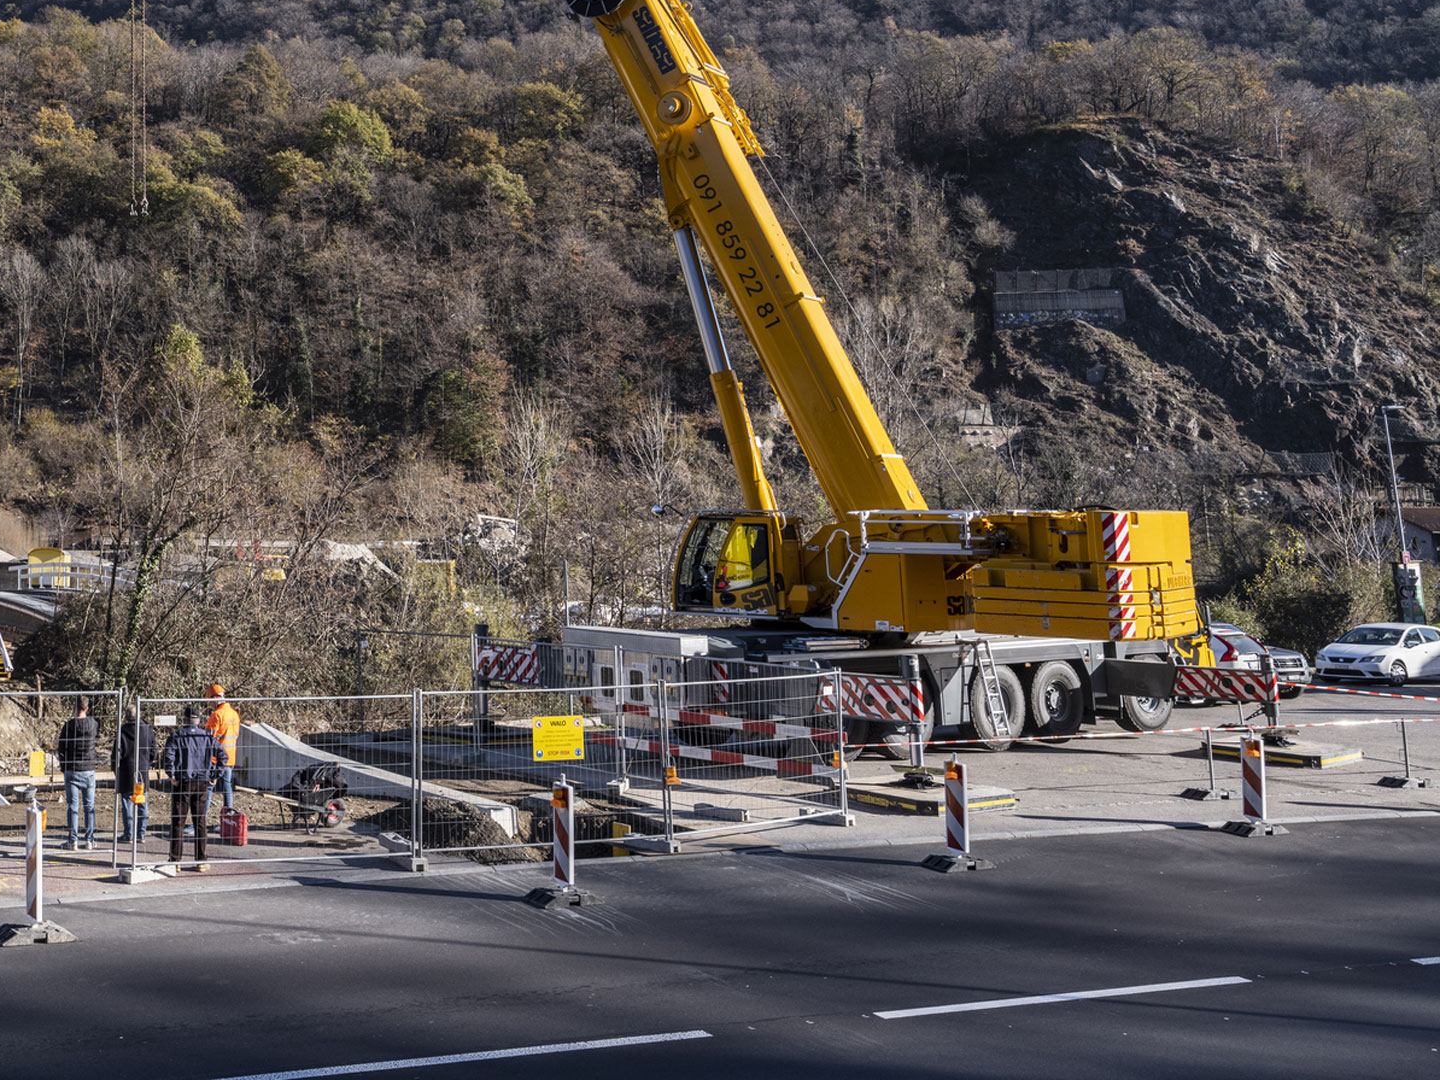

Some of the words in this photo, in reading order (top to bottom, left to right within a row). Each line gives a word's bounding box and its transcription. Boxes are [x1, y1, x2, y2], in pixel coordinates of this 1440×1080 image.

[693, 174, 723, 213] 091
[715, 220, 747, 260] 859
[738, 266, 764, 297] 22
[756, 302, 781, 329] 81
